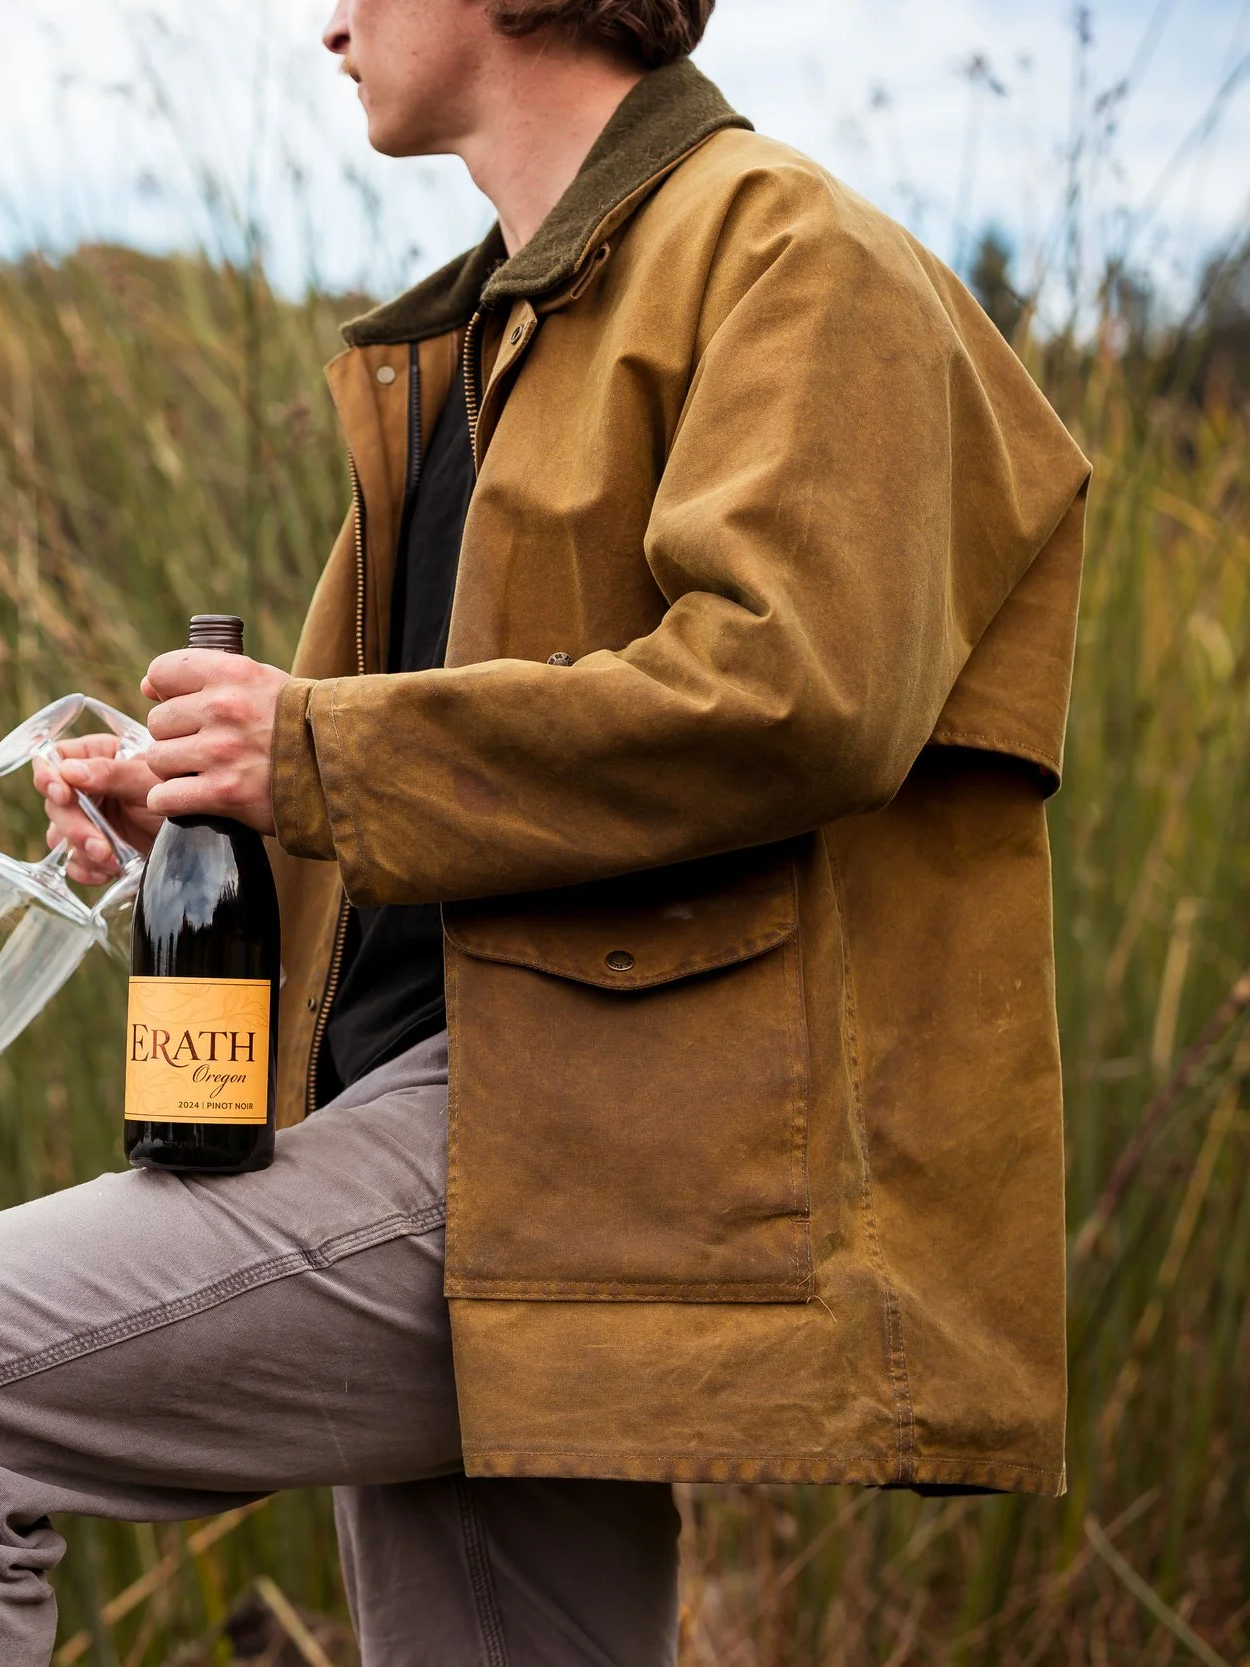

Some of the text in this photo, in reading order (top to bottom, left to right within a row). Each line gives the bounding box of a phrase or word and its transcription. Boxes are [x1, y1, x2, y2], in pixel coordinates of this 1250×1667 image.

[131, 1023, 257, 1068] ERATH
[192, 1063, 247, 1098] Oregon
[178, 1101, 254, 1110] 2024 PINOT NOIR
